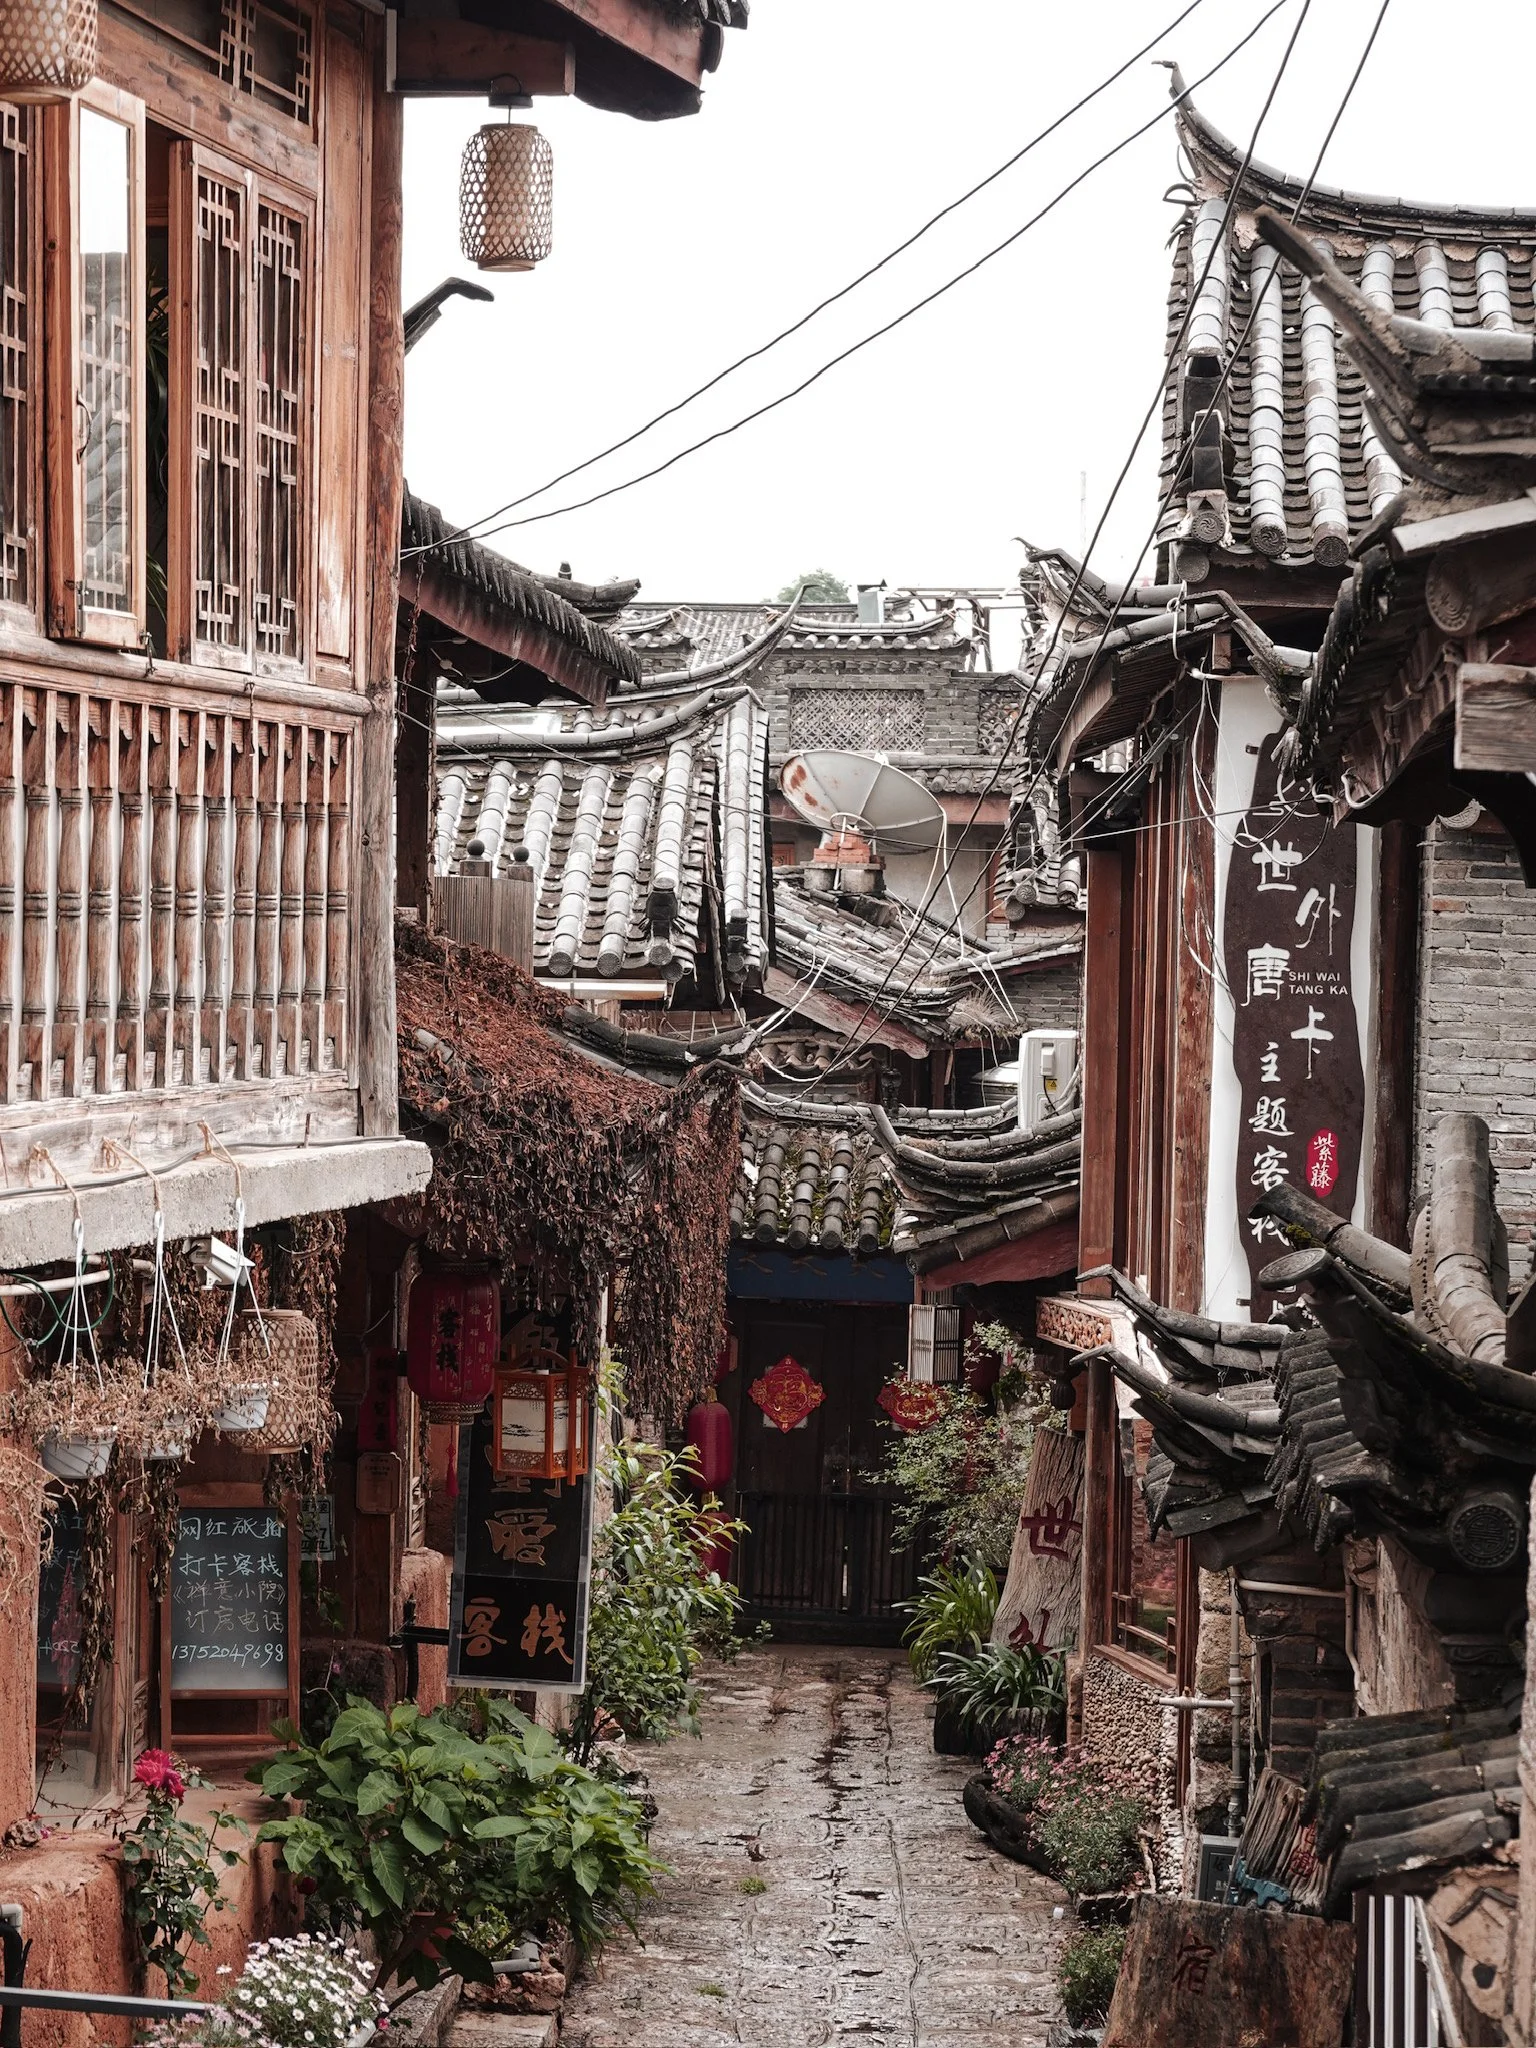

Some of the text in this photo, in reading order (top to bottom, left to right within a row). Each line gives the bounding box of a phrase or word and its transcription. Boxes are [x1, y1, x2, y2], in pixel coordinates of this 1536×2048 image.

[1241, 839, 1342, 1080] 世外唐卡
[1288, 971, 1341, 982] SHI WAI
[1288, 984, 1349, 995] TANG KA
[1310, 1132, 1335, 1189] 紫藤
[179, 1552, 284, 1578] 打卡客栈
[185, 1605, 285, 1637] 订房电话
[456, 1596, 575, 1666] 客栈
[171, 1643, 284, 1669] 13752049698
